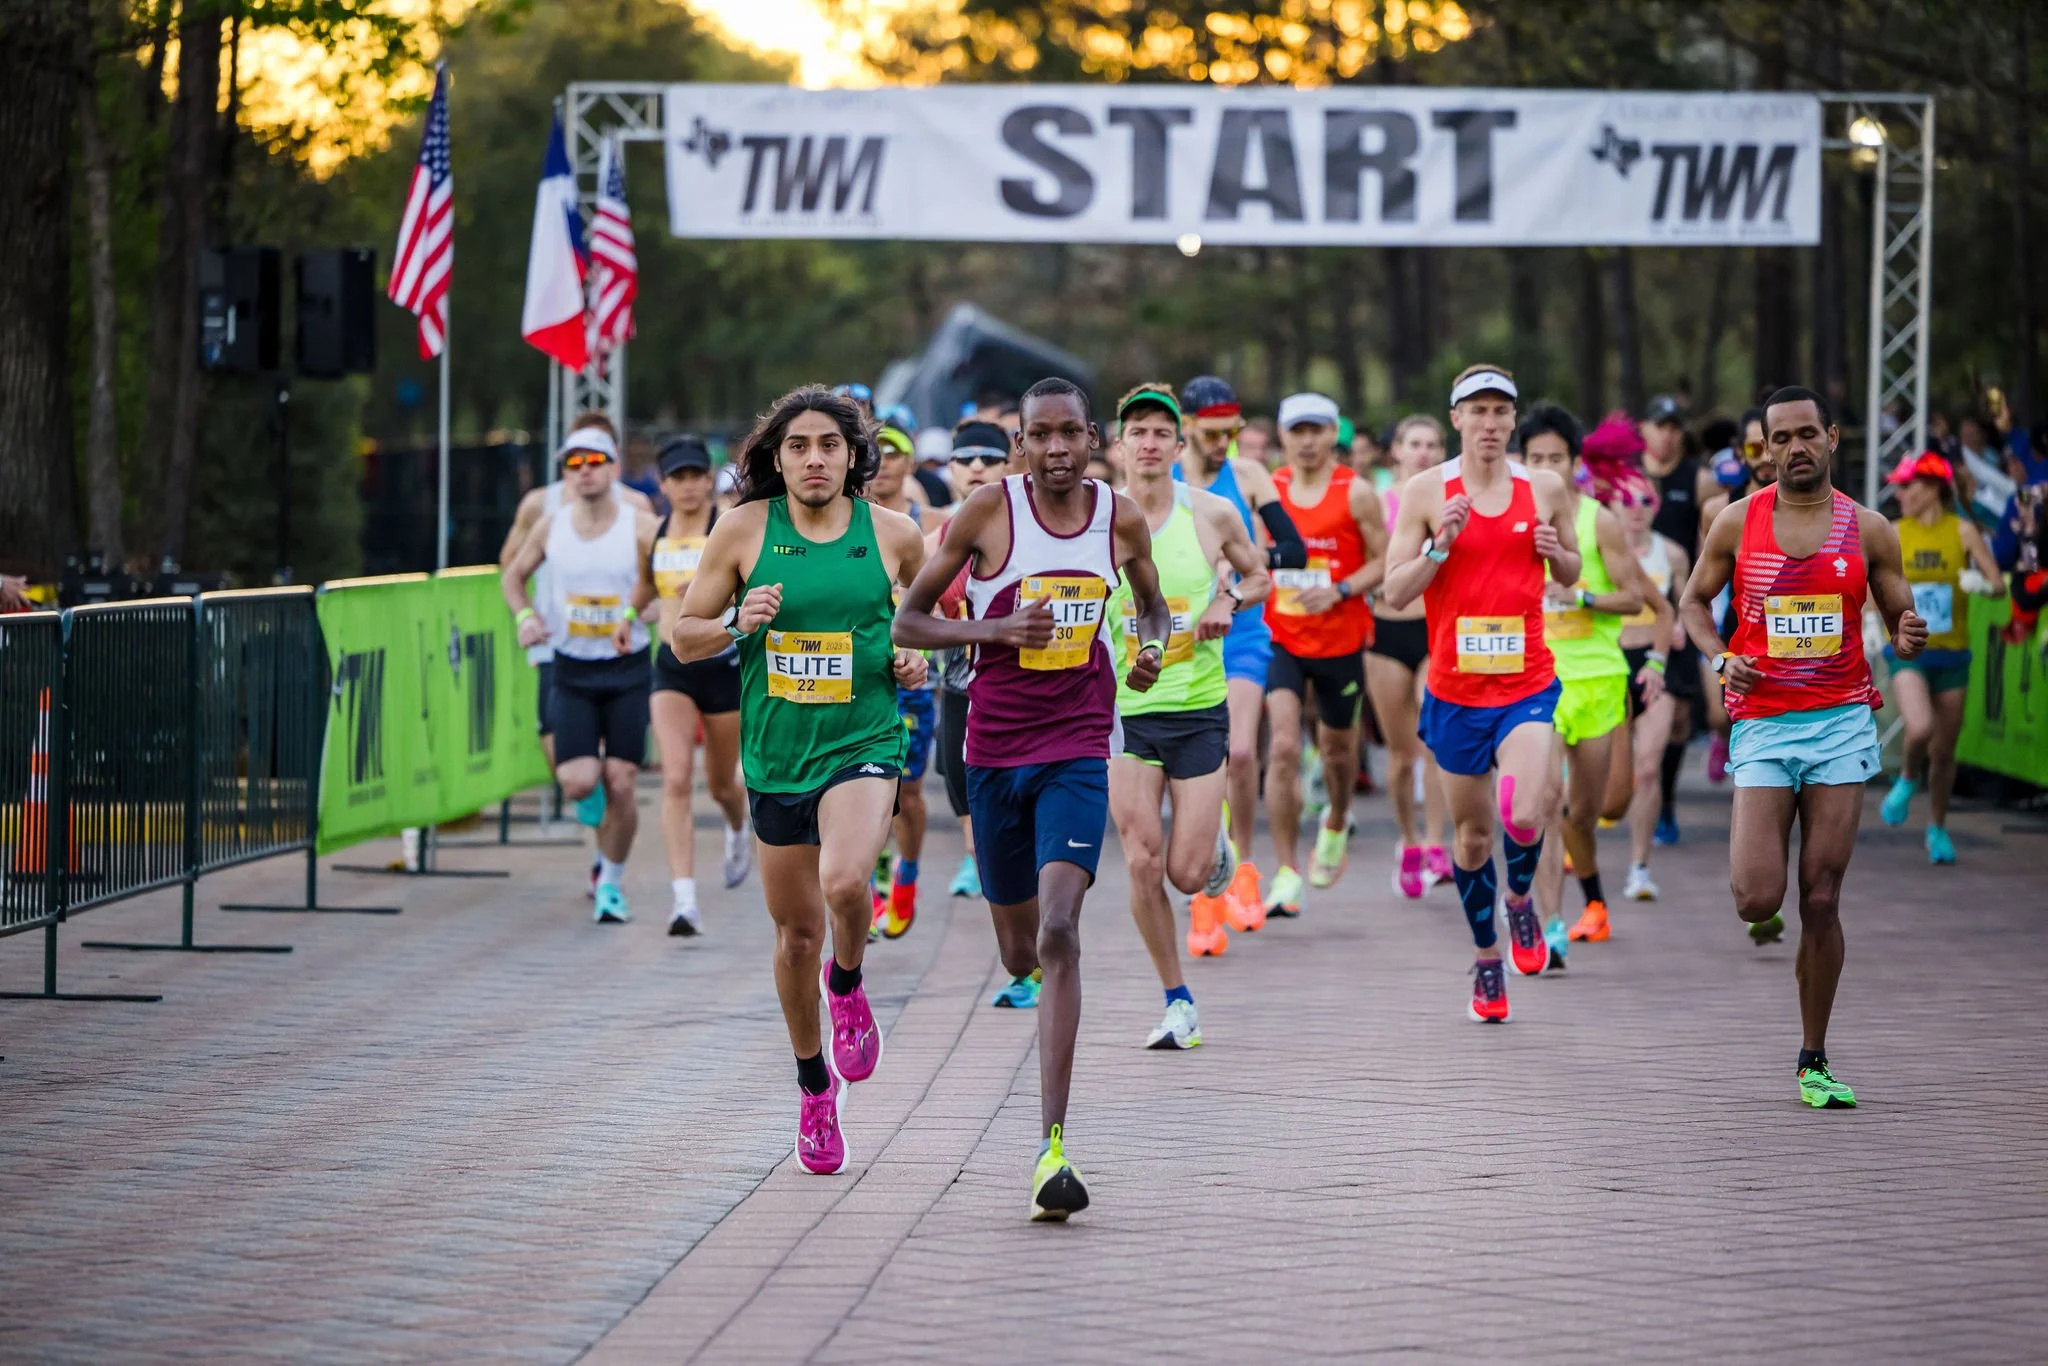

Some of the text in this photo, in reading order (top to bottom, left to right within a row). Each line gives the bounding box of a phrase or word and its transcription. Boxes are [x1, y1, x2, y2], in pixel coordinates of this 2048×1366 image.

[999, 105, 1518, 222] START
[741, 135, 886, 213] TWM
[1651, 144, 1798, 222] TWM
[1060, 585, 1081, 599] TWM
[1049, 602, 1096, 624] LITE
[1797, 601, 1816, 613] TWM
[1774, 615, 1835, 634] ELITE
[1056, 626, 1074, 640] 30
[800, 639, 822, 653] TWM
[1465, 636, 1518, 652] ELITE
[1795, 636, 1813, 648] 26
[774, 653, 842, 676] ELITE
[797, 678, 816, 692] 22
